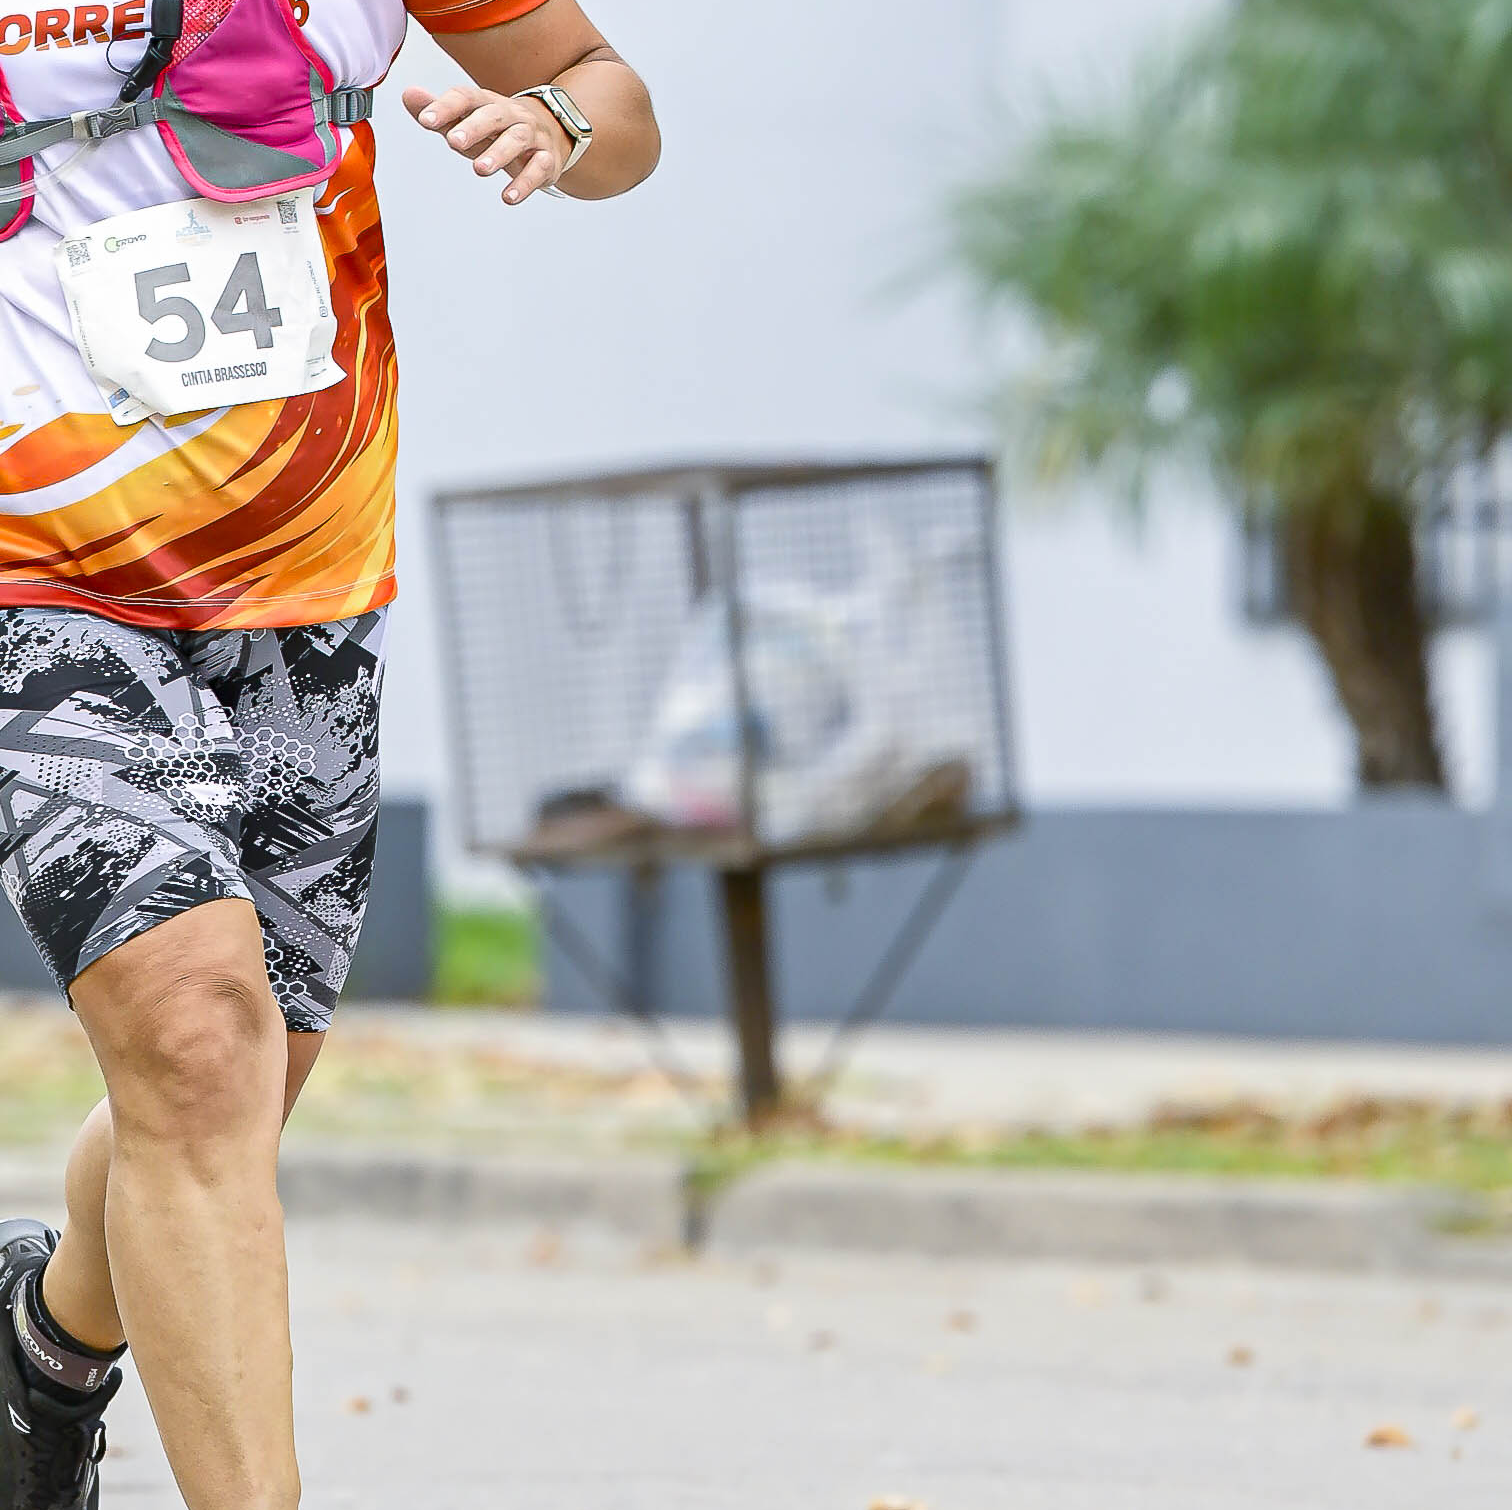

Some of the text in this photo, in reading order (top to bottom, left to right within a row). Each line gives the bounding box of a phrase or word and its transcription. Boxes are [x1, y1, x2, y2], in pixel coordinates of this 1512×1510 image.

[134, 251, 283, 363] 54
[181, 361, 268, 387] CINTIA BRASSESCO
